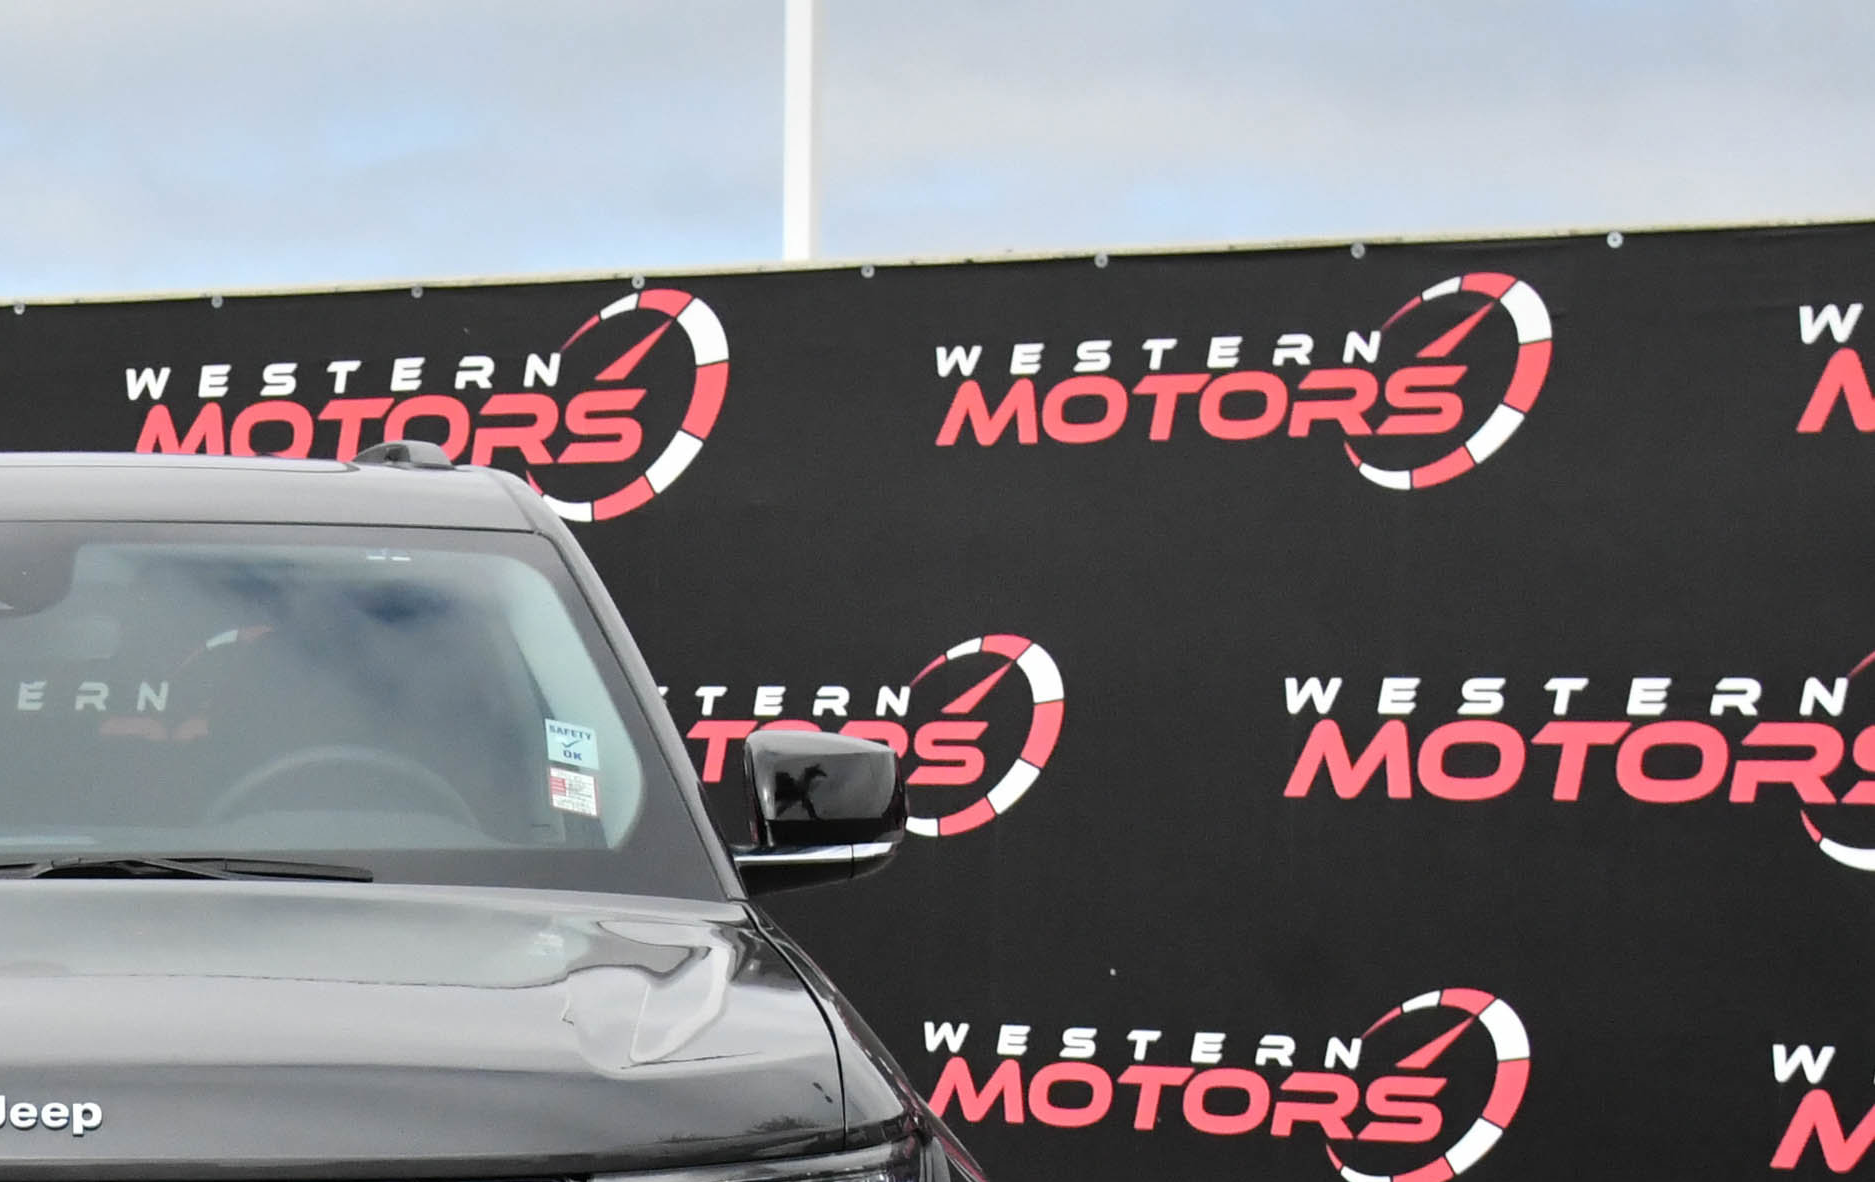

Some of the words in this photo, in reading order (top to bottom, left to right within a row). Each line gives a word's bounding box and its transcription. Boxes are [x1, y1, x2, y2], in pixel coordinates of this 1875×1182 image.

[126, 353, 562, 401] WESTERN
[936, 331, 1381, 378] WESTERN
[135, 388, 647, 466] MOTORS
[937, 365, 1467, 447] MOTORS
[657, 685, 911, 717] TERN
[1284, 677, 1848, 717] WESTERN
[549, 725, 592, 740] SAFETY
[563, 749, 583, 761] OK
[923, 1021, 1362, 1070] WESTERN
[927, 1056, 1448, 1144] MOTORS
